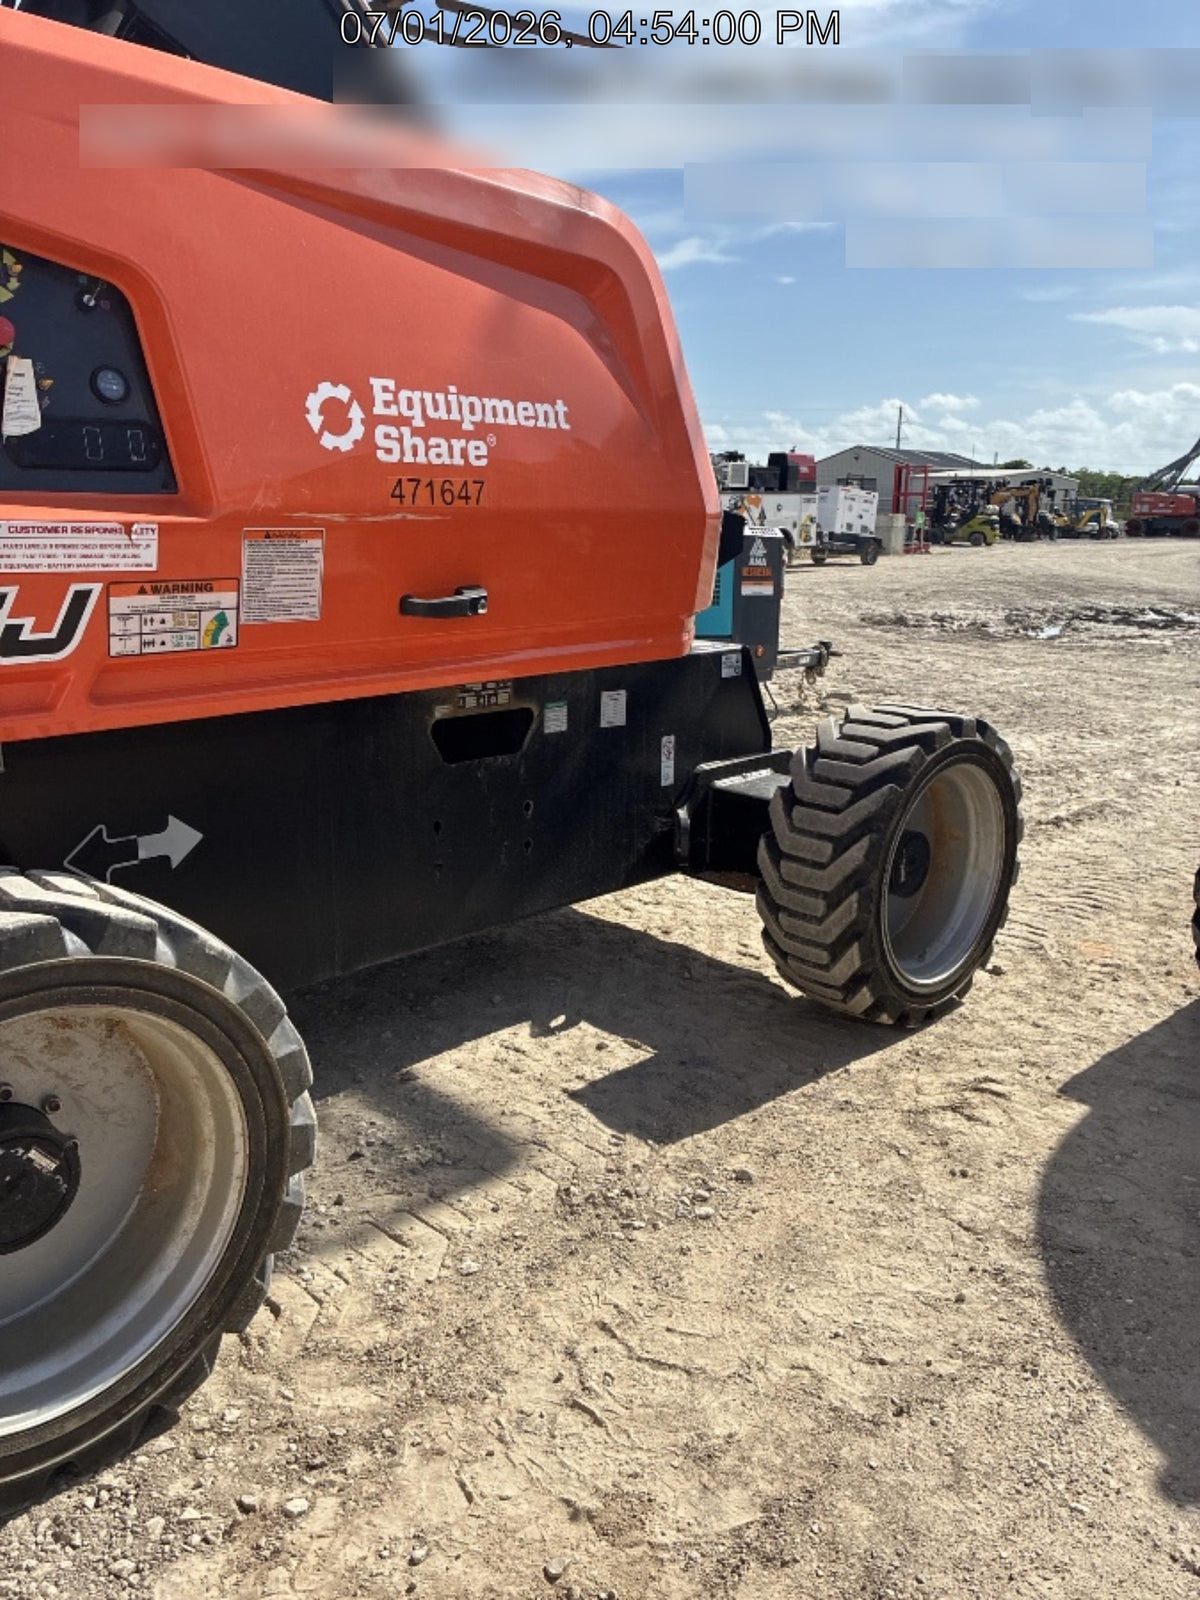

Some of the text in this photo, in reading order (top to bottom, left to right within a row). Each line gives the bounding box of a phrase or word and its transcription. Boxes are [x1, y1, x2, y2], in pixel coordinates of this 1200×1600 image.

[369, 376, 571, 431] Equipment
[390, 477, 485, 506] 471647
[8, 525, 68, 534] CUSTOMER
[151, 582, 214, 595] WARNING
